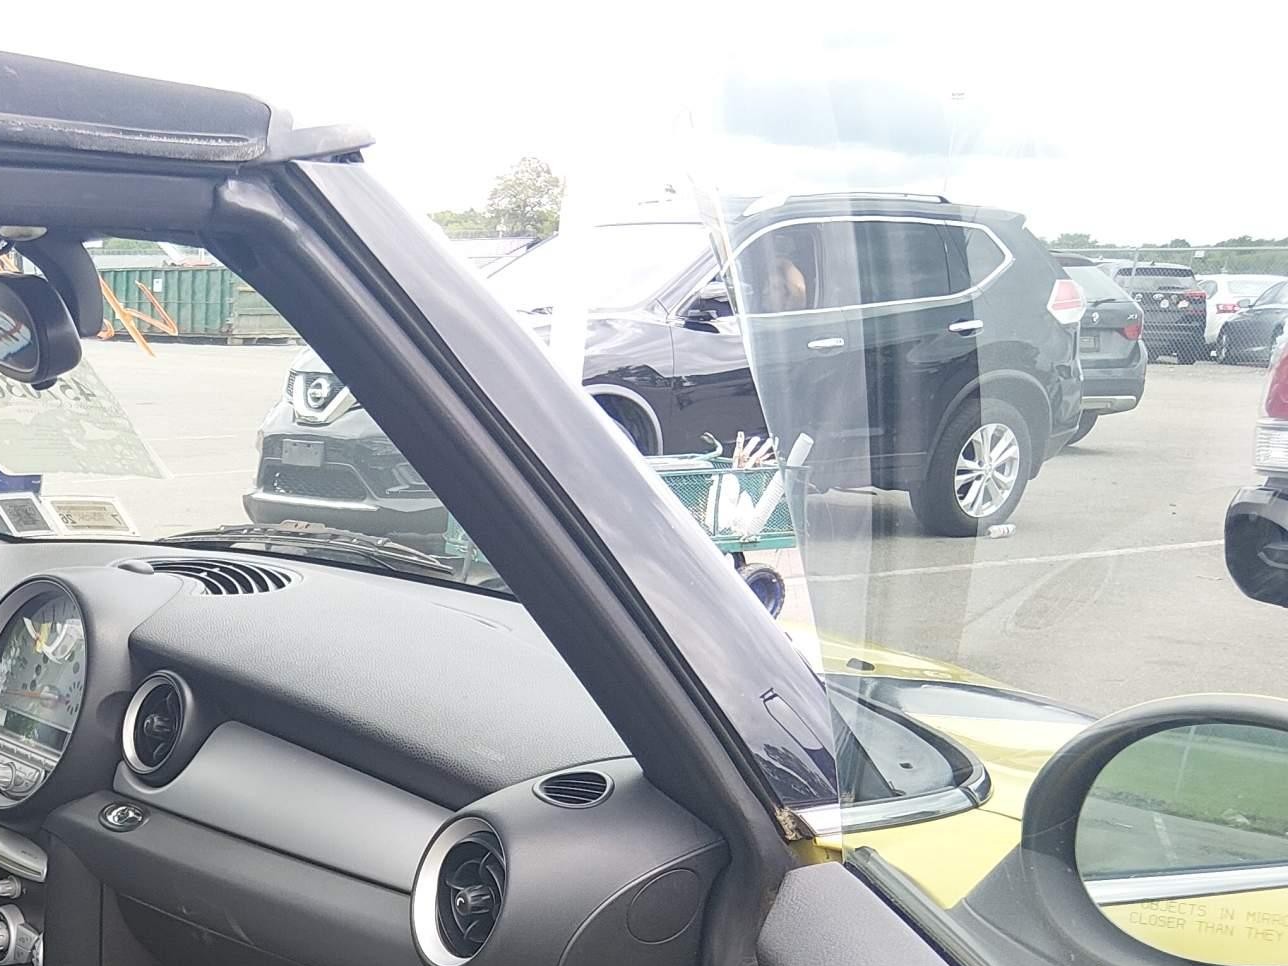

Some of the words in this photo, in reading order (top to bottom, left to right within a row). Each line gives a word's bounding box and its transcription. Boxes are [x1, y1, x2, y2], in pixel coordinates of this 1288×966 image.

[1129, 911, 1186, 929] CLOSER
[1193, 920, 1235, 936] THAN
[1246, 926, 1284, 942] THEY
